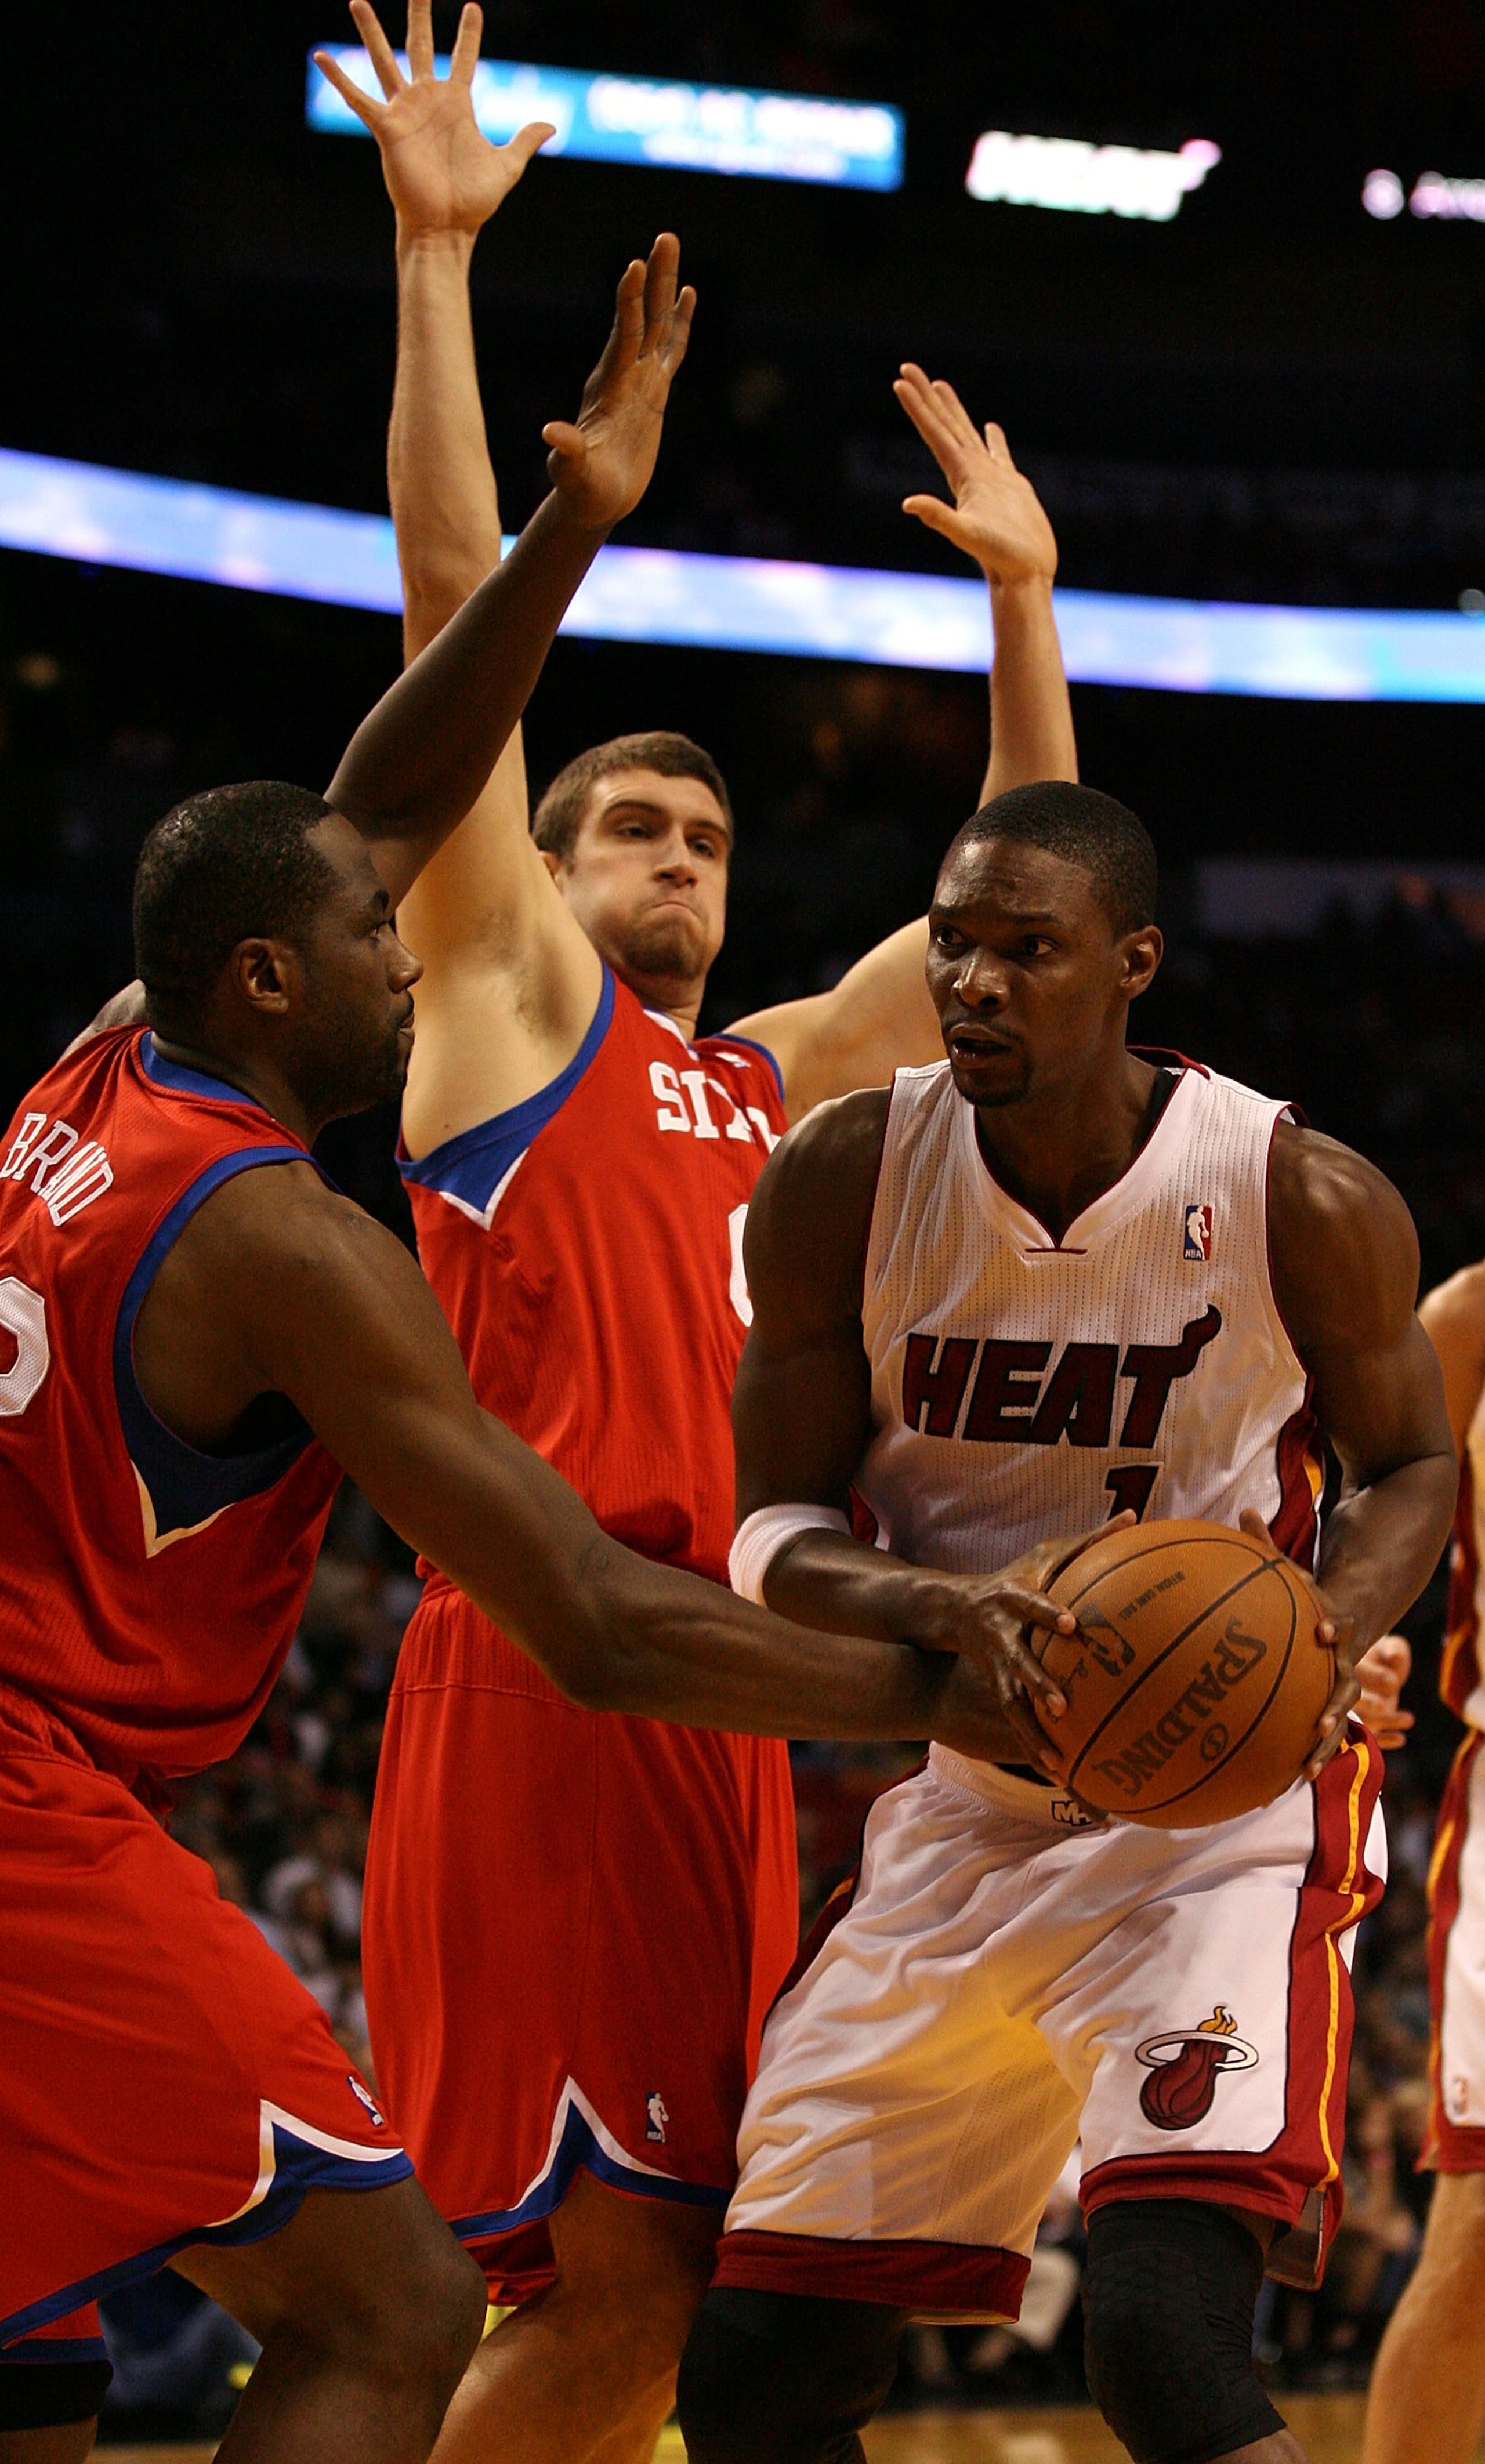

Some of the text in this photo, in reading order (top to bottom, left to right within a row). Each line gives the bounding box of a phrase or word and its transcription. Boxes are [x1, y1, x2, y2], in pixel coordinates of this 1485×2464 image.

[0, 1112, 114, 1226] BRAND
[1185, 1248, 1203, 1259] NBA
[902, 1303, 1223, 1449] HEAT
[1092, 1616, 1267, 1797] SPALDING
